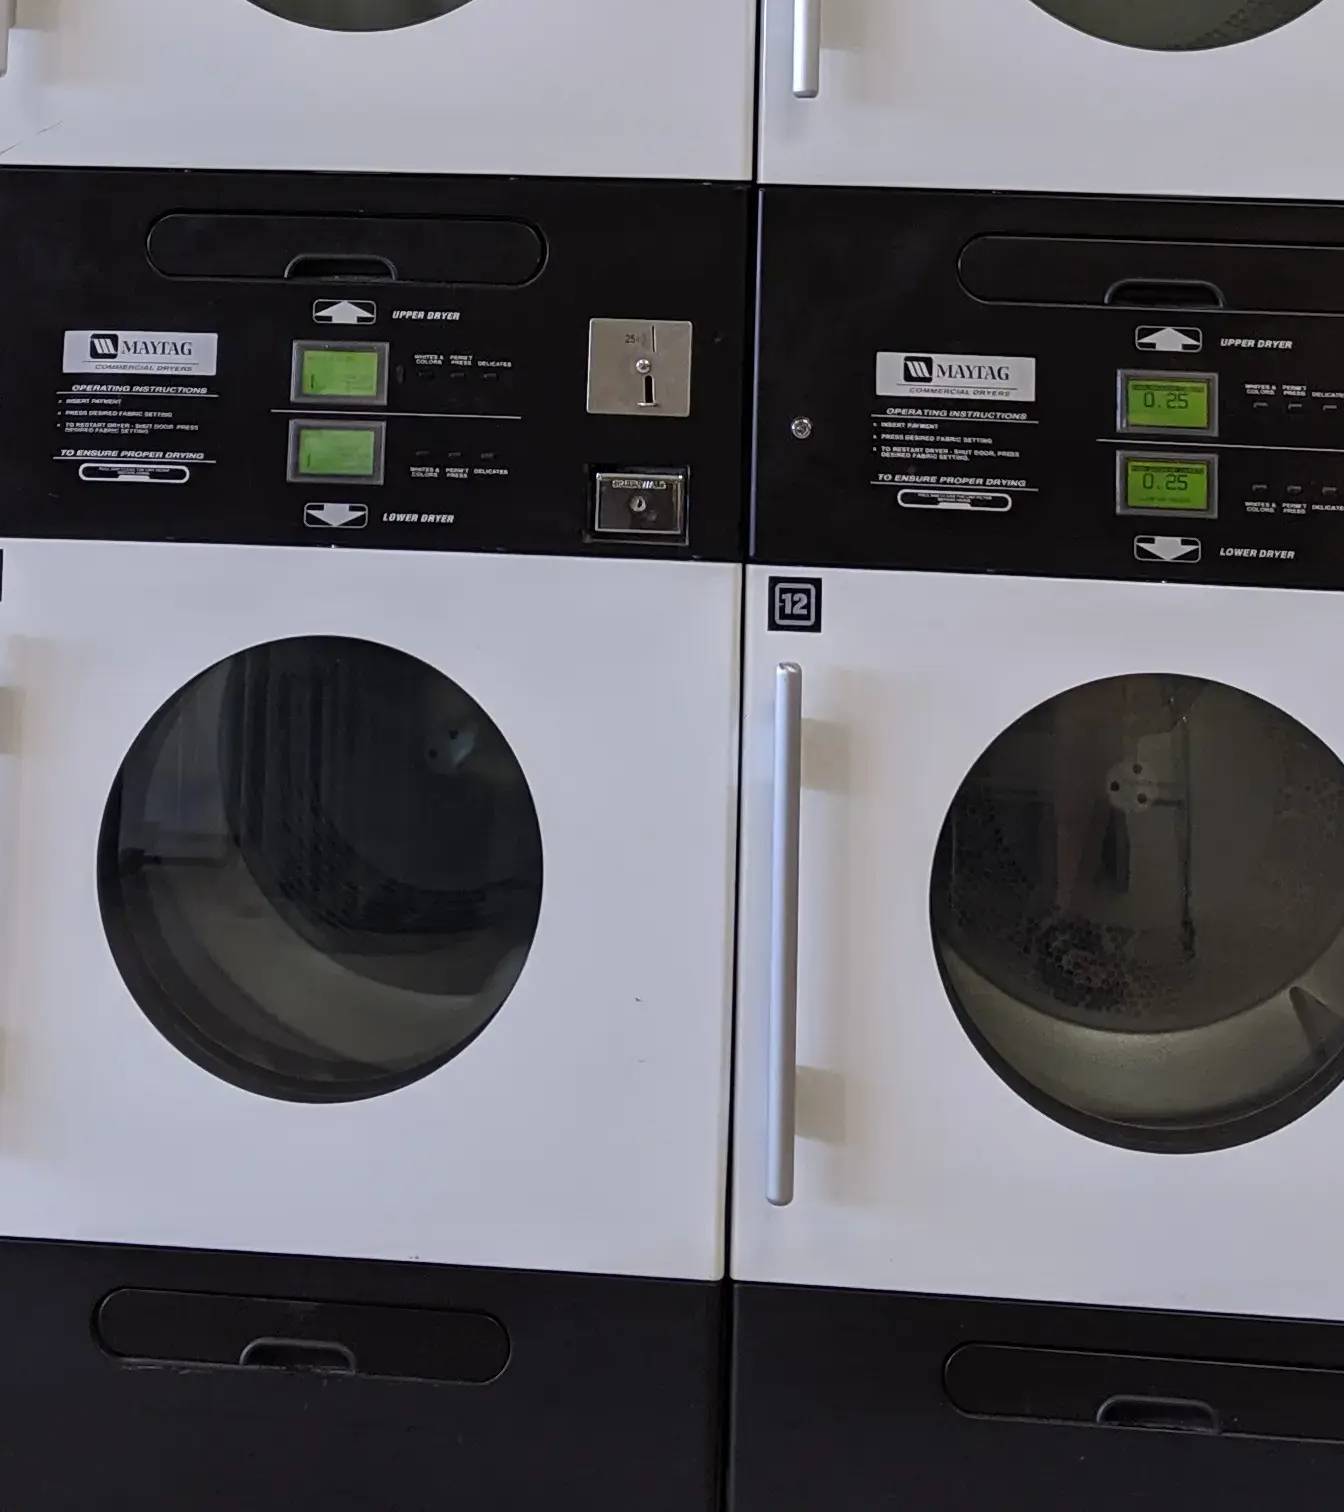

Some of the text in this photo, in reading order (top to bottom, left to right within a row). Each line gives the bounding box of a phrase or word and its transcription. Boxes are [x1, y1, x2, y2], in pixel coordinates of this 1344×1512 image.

[392, 310, 460, 321] UPPER DRYER
[121, 340, 193, 356] MAYTAG
[1220, 338, 1293, 349] UPPER DRYER
[936, 364, 1010, 381] MAYTAG
[72, 384, 208, 394] OPERATING INSTRUCTIONS
[909, 387, 1011, 397] COMMERCIAL DRYERS
[1143, 391, 1188, 409] 0.25
[886, 407, 1027, 420] OPERATING INSTRUCTIONS
[76, 449, 118, 457] ENSURE
[120, 450, 163, 458] PROPER
[165, 451, 204, 460] DRYING
[877, 473, 1026, 487] TO ENSURE PROPER DRYING
[1142, 473, 1188, 491] 0.25
[383, 512, 455, 524] LOWER DRYER
[1219, 548, 1295, 559] LOWER DRYER
[781, 593, 808, 615] 12
